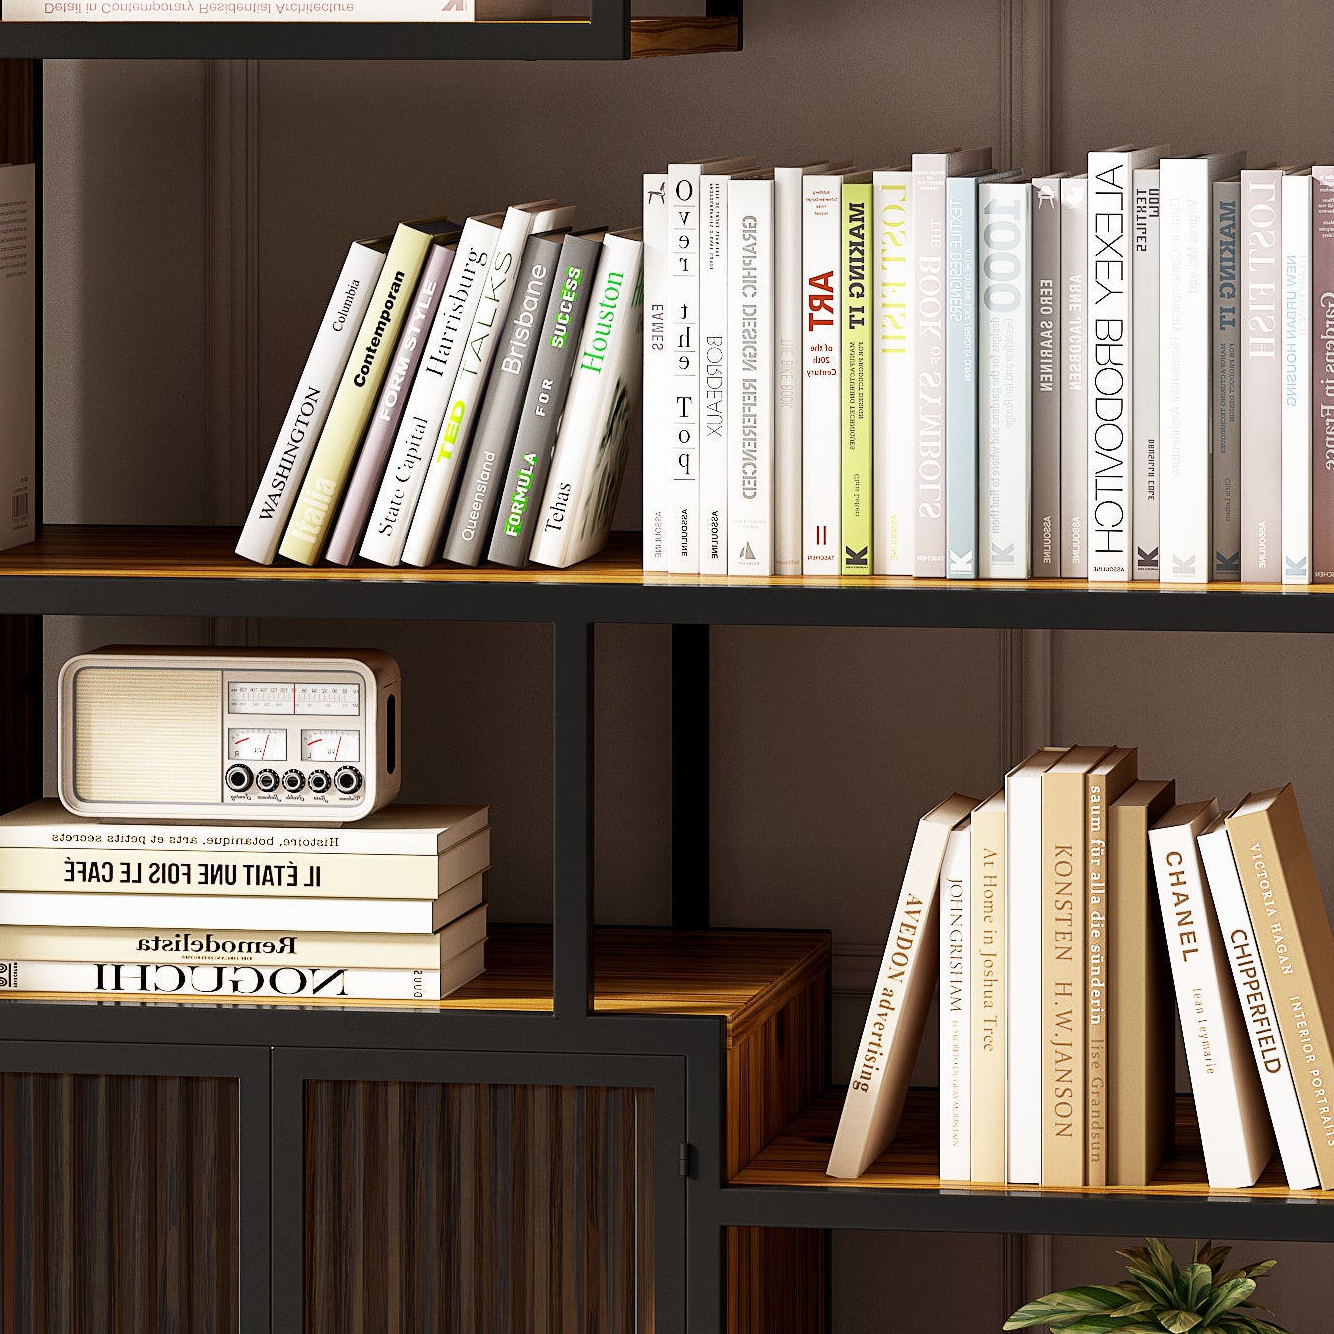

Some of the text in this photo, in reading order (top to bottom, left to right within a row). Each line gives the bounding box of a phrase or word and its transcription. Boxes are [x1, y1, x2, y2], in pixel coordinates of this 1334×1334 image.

[332, 278, 360, 332] Columbia
[380, 280, 438, 422] FORM STYLE
[425, 247, 488, 378] Harrisburg
[436, 251, 513, 464] TED TALKS
[501, 264, 548, 375] Brisbane
[580, 271, 624, 375] Houston
[259, 385, 321, 520] WASHINGTON
[503, 266, 583, 537] FORMULA FOR SUCCESS
[289, 477, 338, 543] Italia
[377, 416, 428, 537] State Capital
[461, 450, 496, 541] Queensland
[979, 847, 999, 1052] At Home in Joshua Tree
[1054, 845, 1073, 962] KONSTEN
[1090, 785, 1105, 1025] saum für alla die sünderin
[1166, 851, 1199, 963] CHANEL
[1250, 842, 1277, 918] VICTORIA
[1269, 922, 1294, 975] HAGAN
[1289, 995, 1316, 1064] INTERIOR
[852, 893, 923, 1093] AVEDON advertising
[1230, 929, 1282, 1075] CHIPPERFIELD
